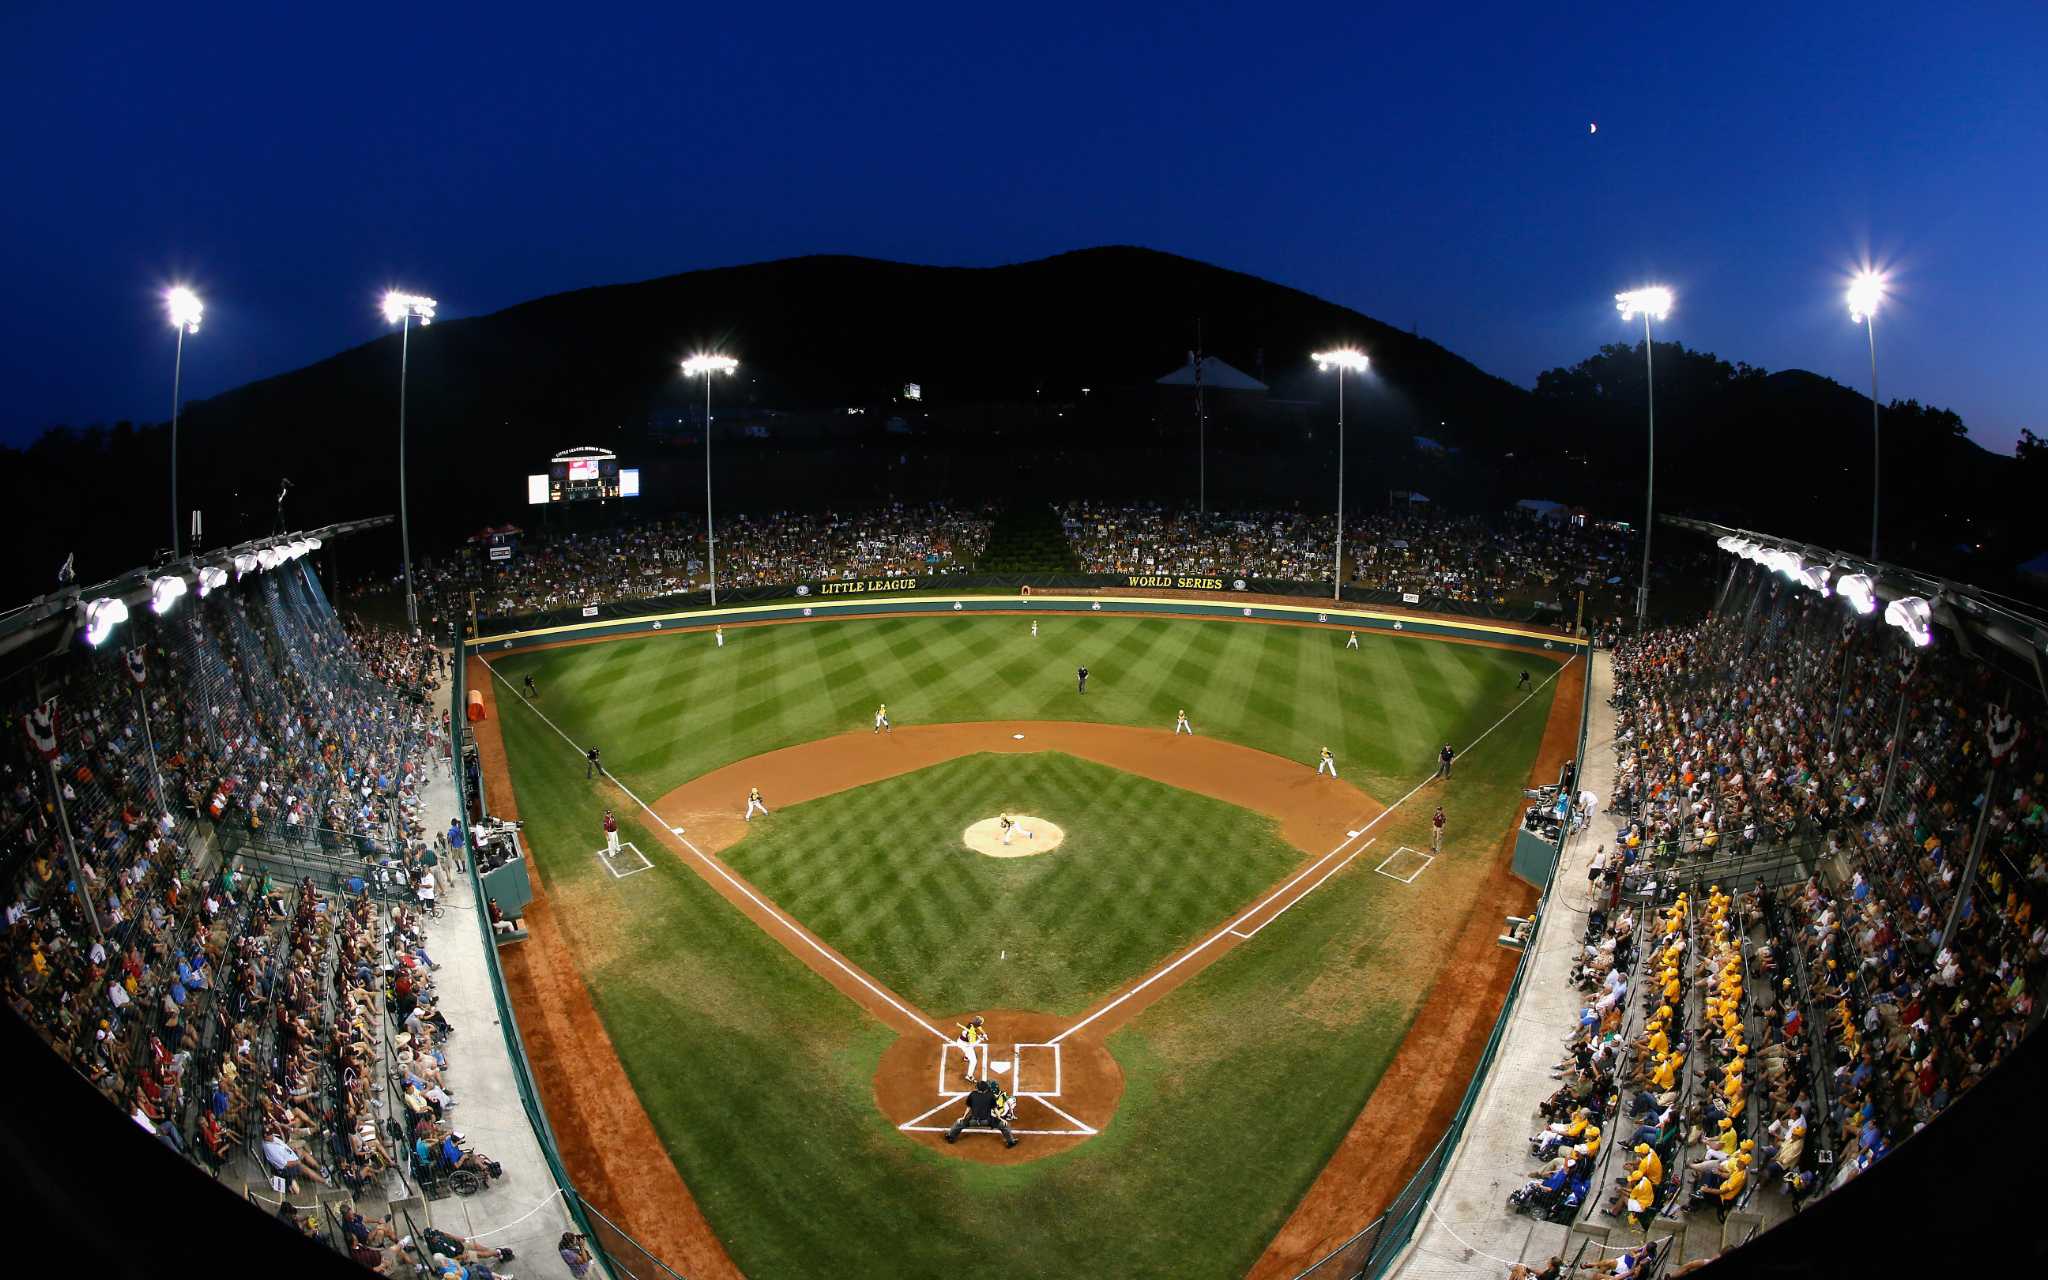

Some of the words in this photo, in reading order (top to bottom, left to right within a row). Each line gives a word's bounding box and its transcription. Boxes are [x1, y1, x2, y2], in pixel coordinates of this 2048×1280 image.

[821, 581, 864, 594] LITTLE
[868, 578, 916, 592] LEAGUE
[1128, 576, 1172, 587] WORLD
[1177, 577, 1223, 590] SERIES
